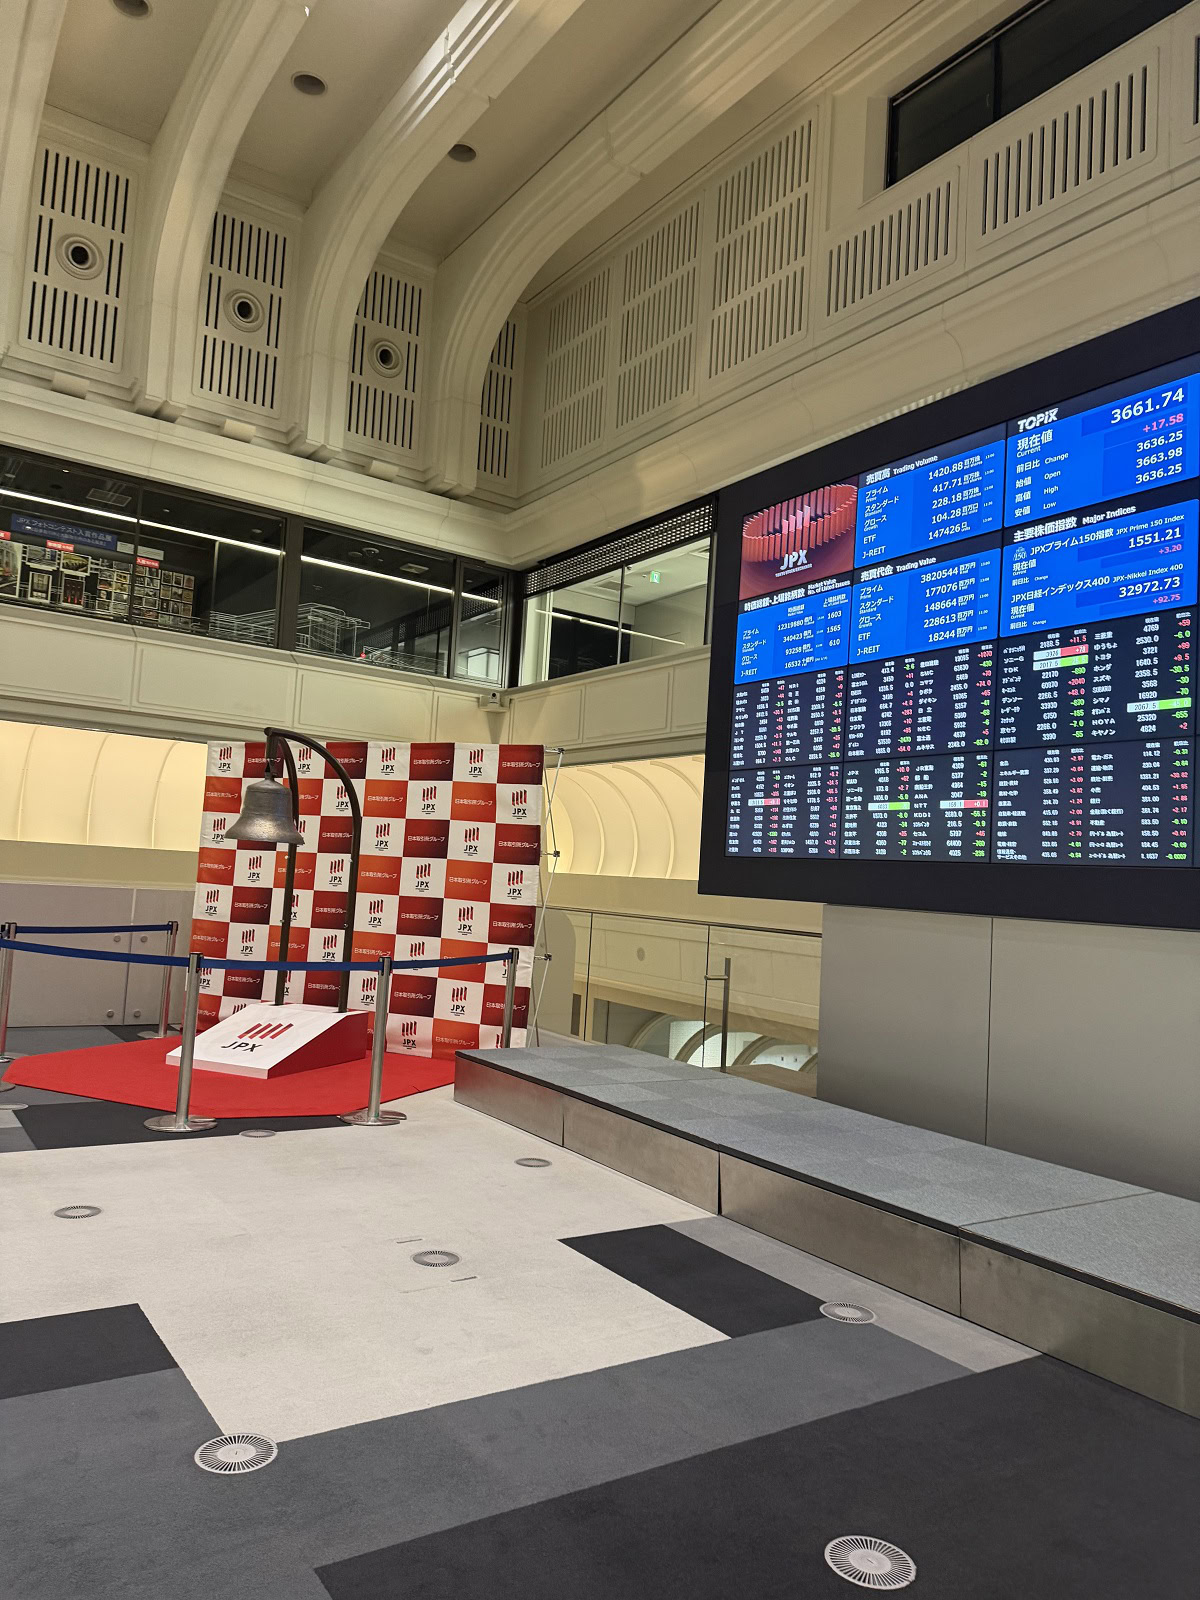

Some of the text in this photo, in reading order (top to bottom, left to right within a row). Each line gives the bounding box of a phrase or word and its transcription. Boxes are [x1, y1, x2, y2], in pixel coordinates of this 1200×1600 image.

[1017, 388, 1184, 451] 現在値 3661.74
[1016, 413, 1184, 474] 前日比 Change +17.58
[1016, 446, 1041, 458] Current
[893, 462, 915, 475] Trading
[915, 455, 938, 467] Volume
[1015, 430, 1183, 489] 始値 Open 3636.25
[865, 461, 964, 498] プライム 1420.88
[1043, 485, 1059, 496] High
[1135, 447, 1183, 468] 3663.98
[865, 477, 962, 514] スタンダード 417.71
[1014, 463, 1182, 518] 安値 Low 3636.25
[864, 492, 962, 528] グロース 228.18
[863, 508, 962, 544] ETF 104.28
[1013, 506, 1137, 542] 主要株価指数 Major Indices
[862, 523, 961, 559] J-REIT 147426
[1030, 514, 1185, 556] JPXプライム150指数 JPX Prime 150 Index
[1012, 527, 1182, 572] 現在値 1551.21
[1158, 544, 1182, 554] +3.20
[780, 549, 808, 570] JPX
[896, 561, 919, 572] Trading
[919, 556, 937, 566] Value
[860, 584, 883, 596] プライム
[920, 566, 959, 584] 3820544
[1011, 576, 1110, 603] JPX日経インデックス400
[1148, 567, 1169, 576] Index
[1169, 563, 1184, 572] 400
[859, 595, 894, 610] スタンダード
[925, 582, 958, 598] 177076
[1010, 576, 1181, 616] 現在値 32972.73
[1152, 593, 1181, 604] +92.75
[859, 613, 882, 625] グロース
[924, 597, 957, 613] 148664
[857, 632, 871, 642] ETF
[923, 613, 956, 628] 228613
[856, 645, 880, 656] J-REIT
[928, 630, 955, 643] 18244
[218, 762, 231, 770] JPX
[298, 763, 311, 771] JPX
[381, 764, 395, 772] JPX
[469, 766, 483, 774] JPX
[422, 803, 436, 811] JPX
[512, 808, 527, 816] JPX
[212, 833, 224, 841] JPX
[375, 840, 389, 848] JPX
[415, 880, 429, 888] JPX
[507, 888, 522, 896] JPX
[205, 905, 218, 913] JPX
[368, 916, 382, 924] JPX
[458, 924, 472, 932] JPX
[241, 945, 254, 953] JPX
[361, 994, 375, 1002] JPX
[450, 1004, 466, 1012] JPX
[221, 1041, 263, 1052] JPX
[402, 1038, 416, 1046] JPX
